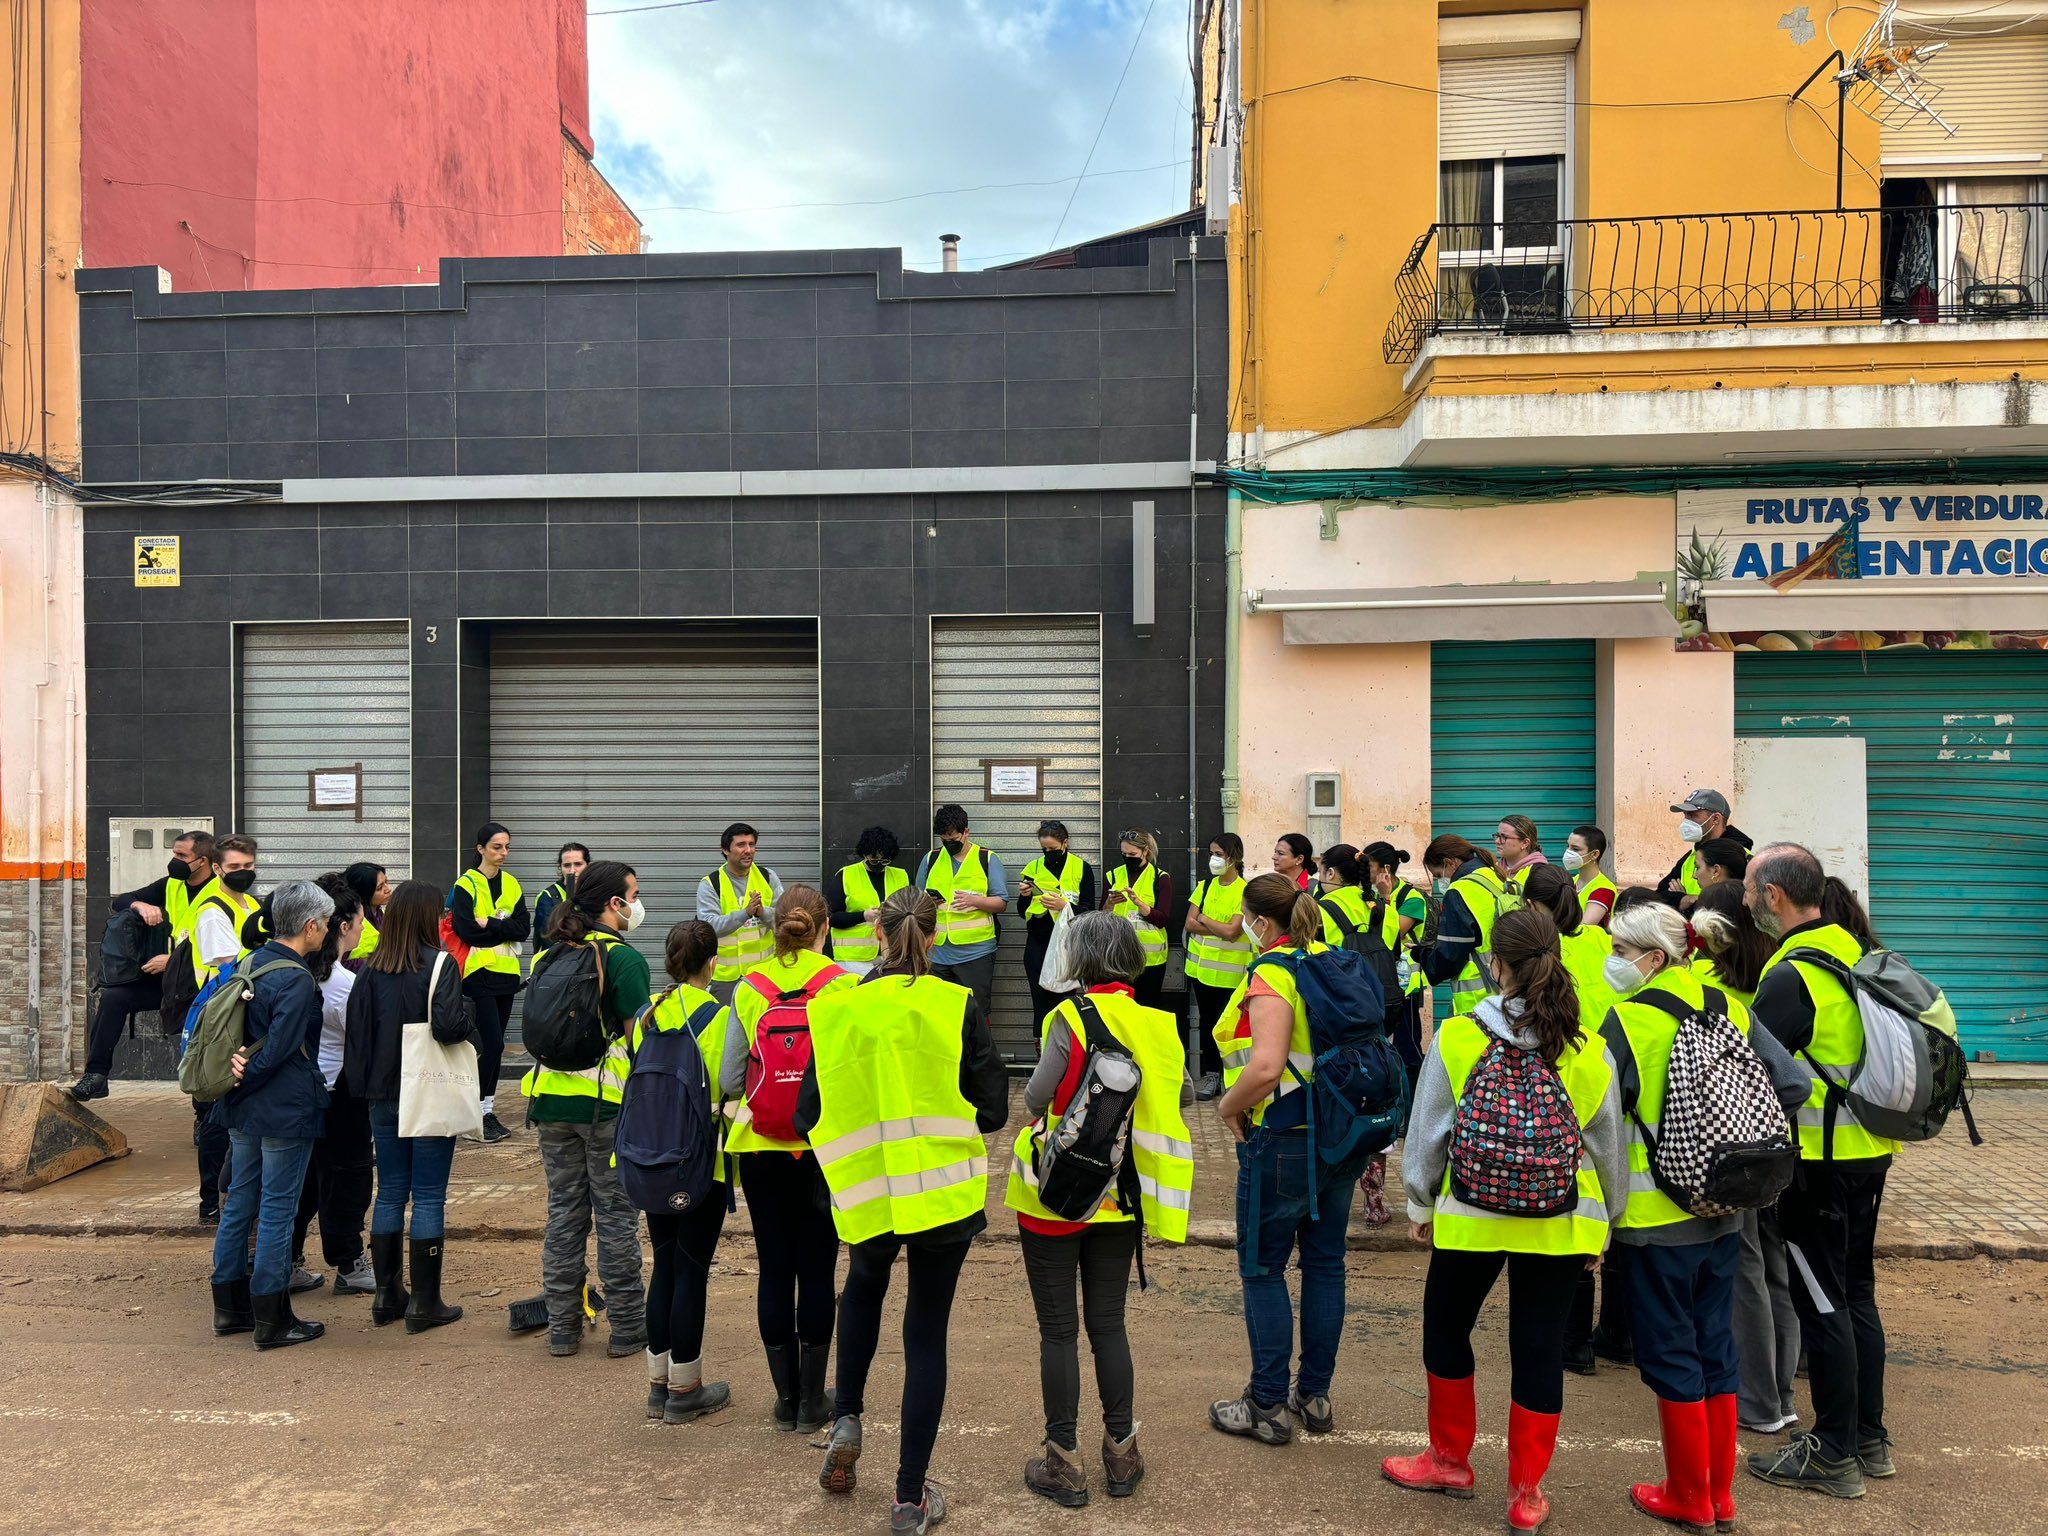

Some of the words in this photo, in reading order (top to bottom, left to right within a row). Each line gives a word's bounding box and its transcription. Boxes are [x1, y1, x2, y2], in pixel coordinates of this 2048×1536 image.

[1746, 496, 1871, 525] FRUTAS
[1878, 496, 1903, 522] Y
[1910, 494, 2048, 522] VERDUR
[426, 625, 438, 643] 3
